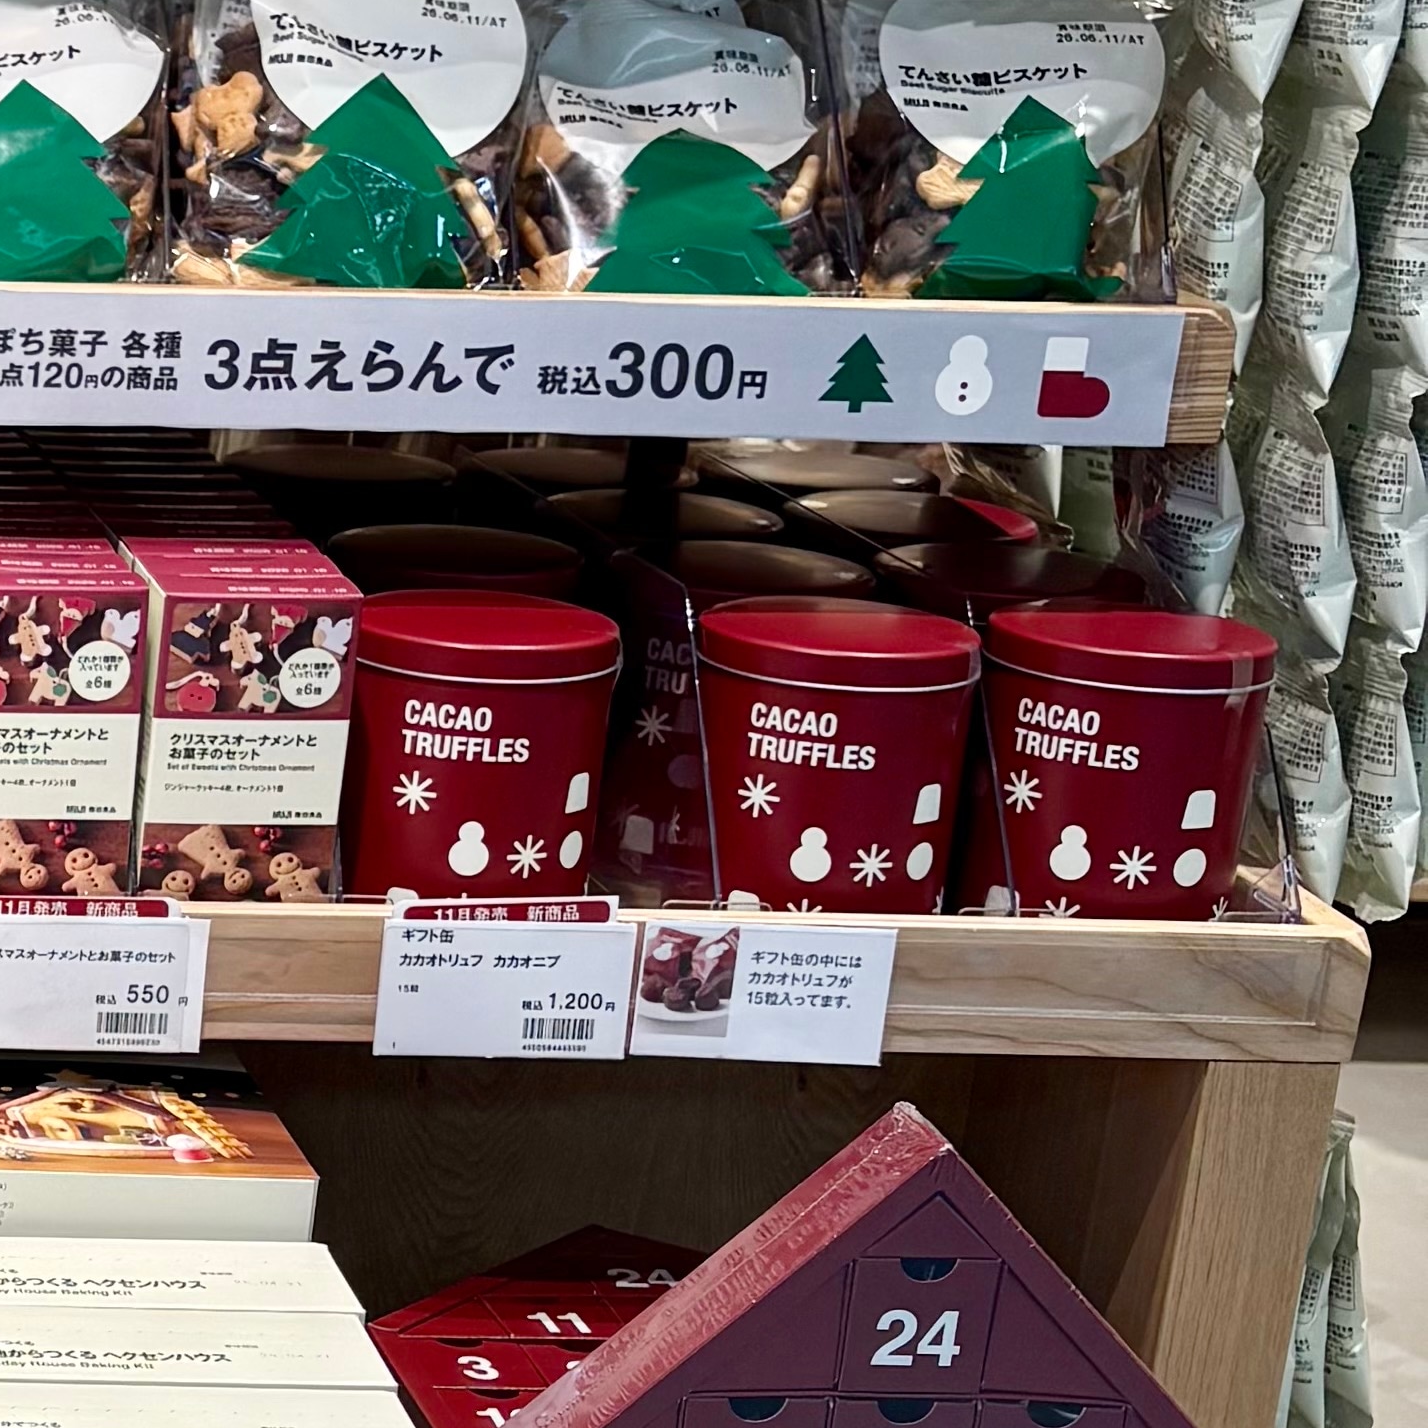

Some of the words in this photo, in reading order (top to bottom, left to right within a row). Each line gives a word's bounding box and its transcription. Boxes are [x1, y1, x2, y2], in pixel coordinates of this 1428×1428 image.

[121, 330, 182, 360] 各種
[204, 338, 516, 394] 3点えらんで
[405, 700, 493, 731] CACAO
[751, 702, 838, 737] CACAO
[1018, 698, 1101, 736] CACAO
[170, 733, 319, 749] クリスマスオーナメントと
[170, 746, 261, 762] お菓子のセット
[401, 729, 530, 764] TRUFFLES
[747, 732, 876, 771] TRUFFLES
[1015, 728, 1140, 771] TRUFFLES
[401, 927, 455, 944] ギフト缶
[398, 951, 483, 970] カカオトリュフ
[750, 950, 861, 970] ギフト缶の中には
[126, 982, 170, 1006] 550
[748, 971, 854, 991] カカオトリュフが
[747, 989, 853, 1011] 15粒入ってます。
[870, 1310, 961, 1367] 24
